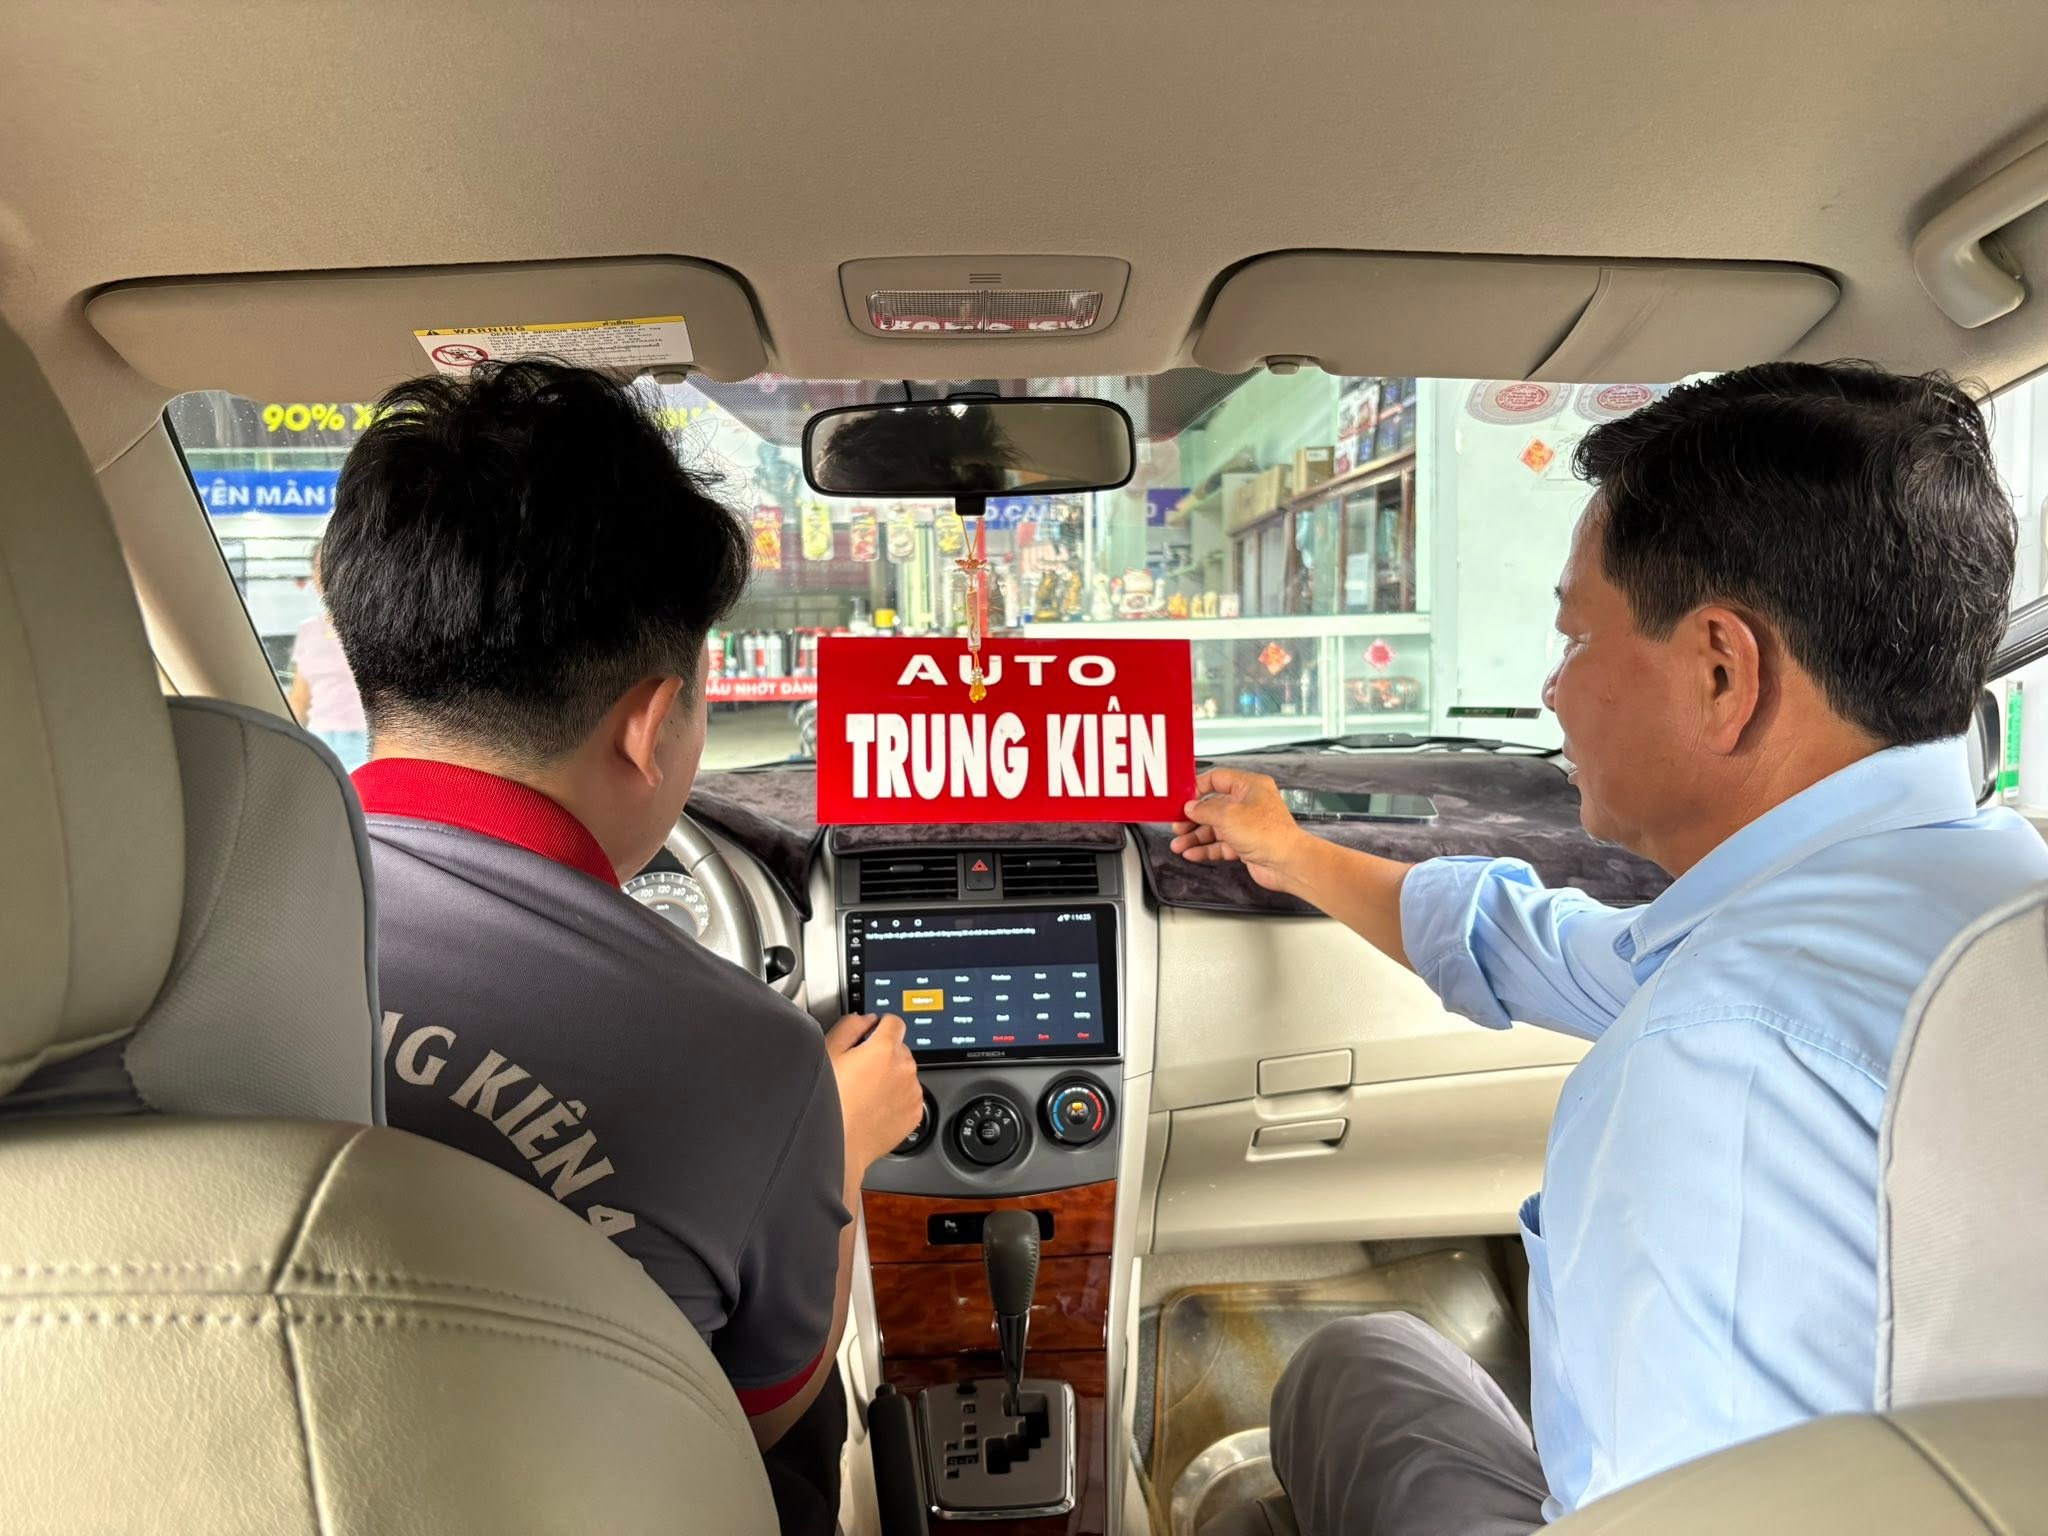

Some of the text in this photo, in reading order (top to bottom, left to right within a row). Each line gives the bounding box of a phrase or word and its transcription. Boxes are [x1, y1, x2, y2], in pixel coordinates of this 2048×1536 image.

[453, 325, 526, 335] WARNING
[262, 403, 346, 432] 90%
[897, 653, 1117, 687] AUTO
[845, 695, 1168, 800] TRUNG KIÊN
[448, 1048, 615, 1202] KIÊN
[984, 1106, 991, 1115] 2
[994, 1108, 1003, 1117] 3
[1002, 1117, 1011, 1125] 4
